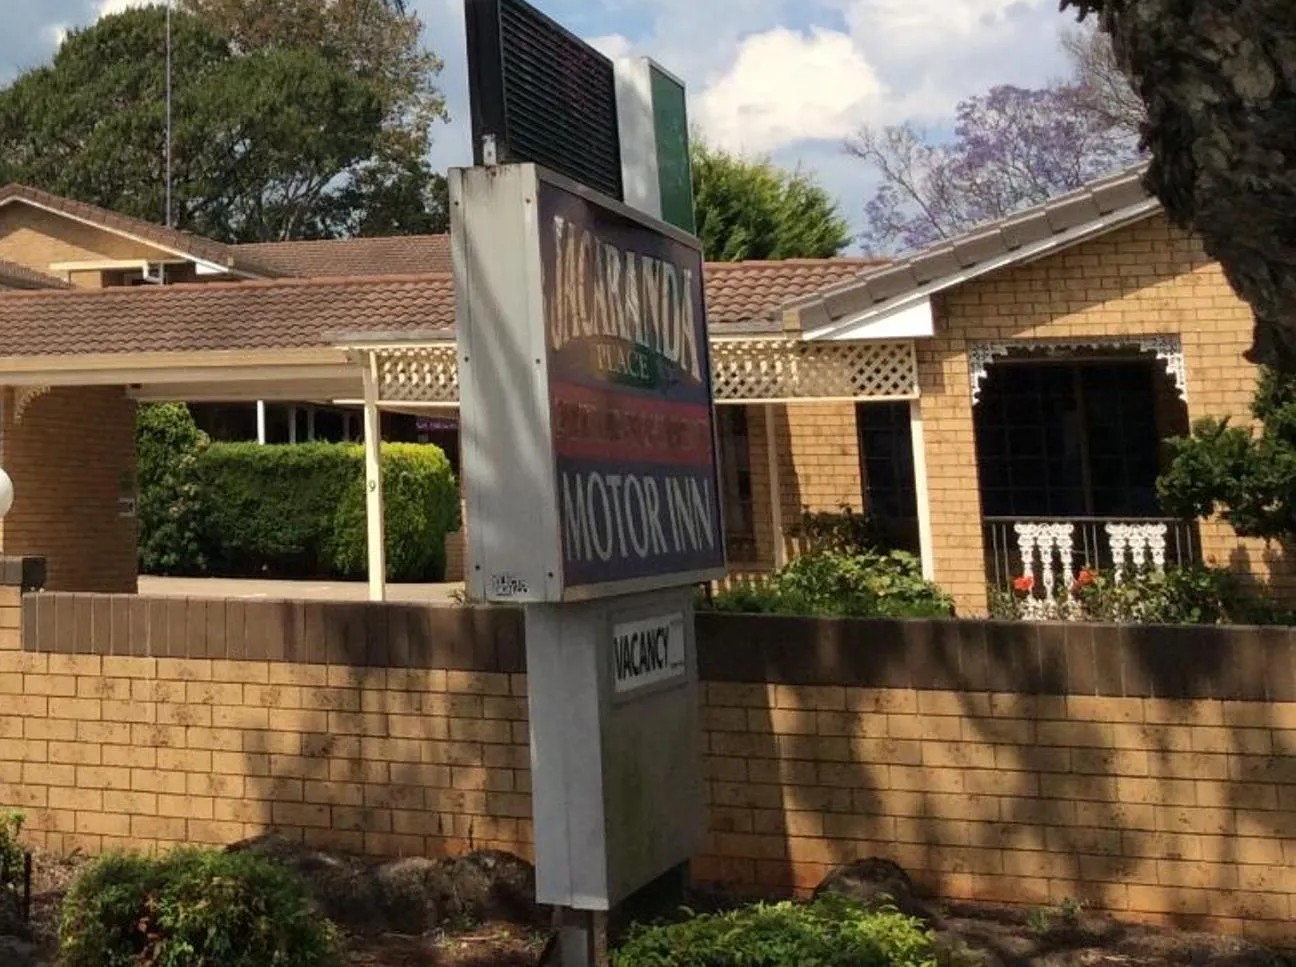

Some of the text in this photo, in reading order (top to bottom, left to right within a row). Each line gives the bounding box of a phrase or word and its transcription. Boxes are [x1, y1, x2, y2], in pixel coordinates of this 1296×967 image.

[551, 215, 703, 383] JACARANDA
[596, 344, 650, 379] PLACE
[563, 471, 714, 562] MOTOR INN
[613, 625, 670, 681] VACANCY
